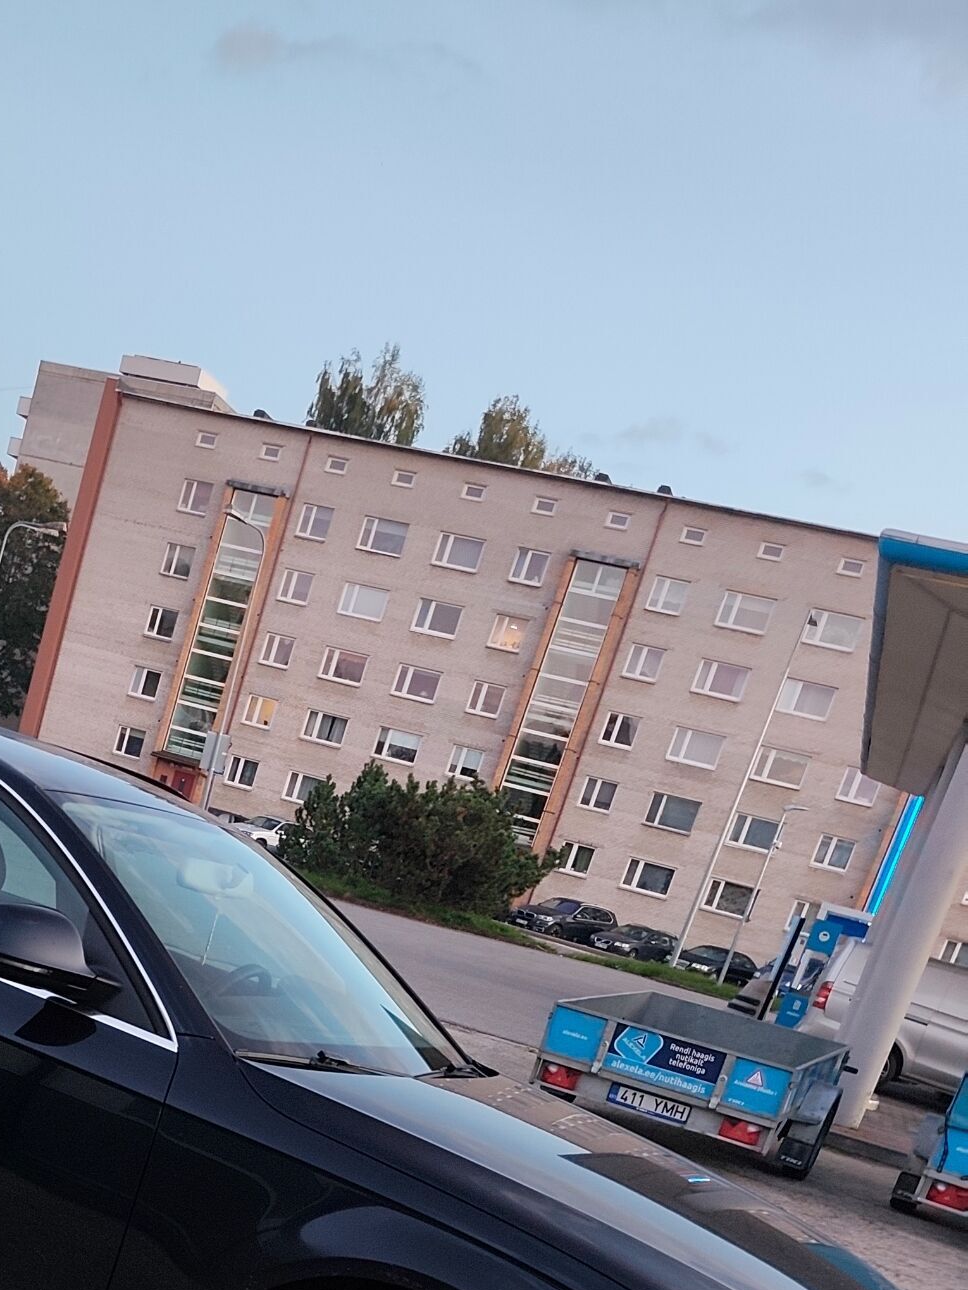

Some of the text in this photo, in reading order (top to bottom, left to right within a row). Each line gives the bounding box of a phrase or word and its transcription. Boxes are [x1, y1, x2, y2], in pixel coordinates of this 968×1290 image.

[670, 1043, 715, 1062] Rendi haagis
[675, 1053, 704, 1067] nutikalt
[669, 1058, 706, 1075] telefoniga
[611, 1059, 706, 1095] alexela.ee/nutihaagis
[620, 1089, 645, 1107] 411
[654, 1098, 687, 1119] YMH
